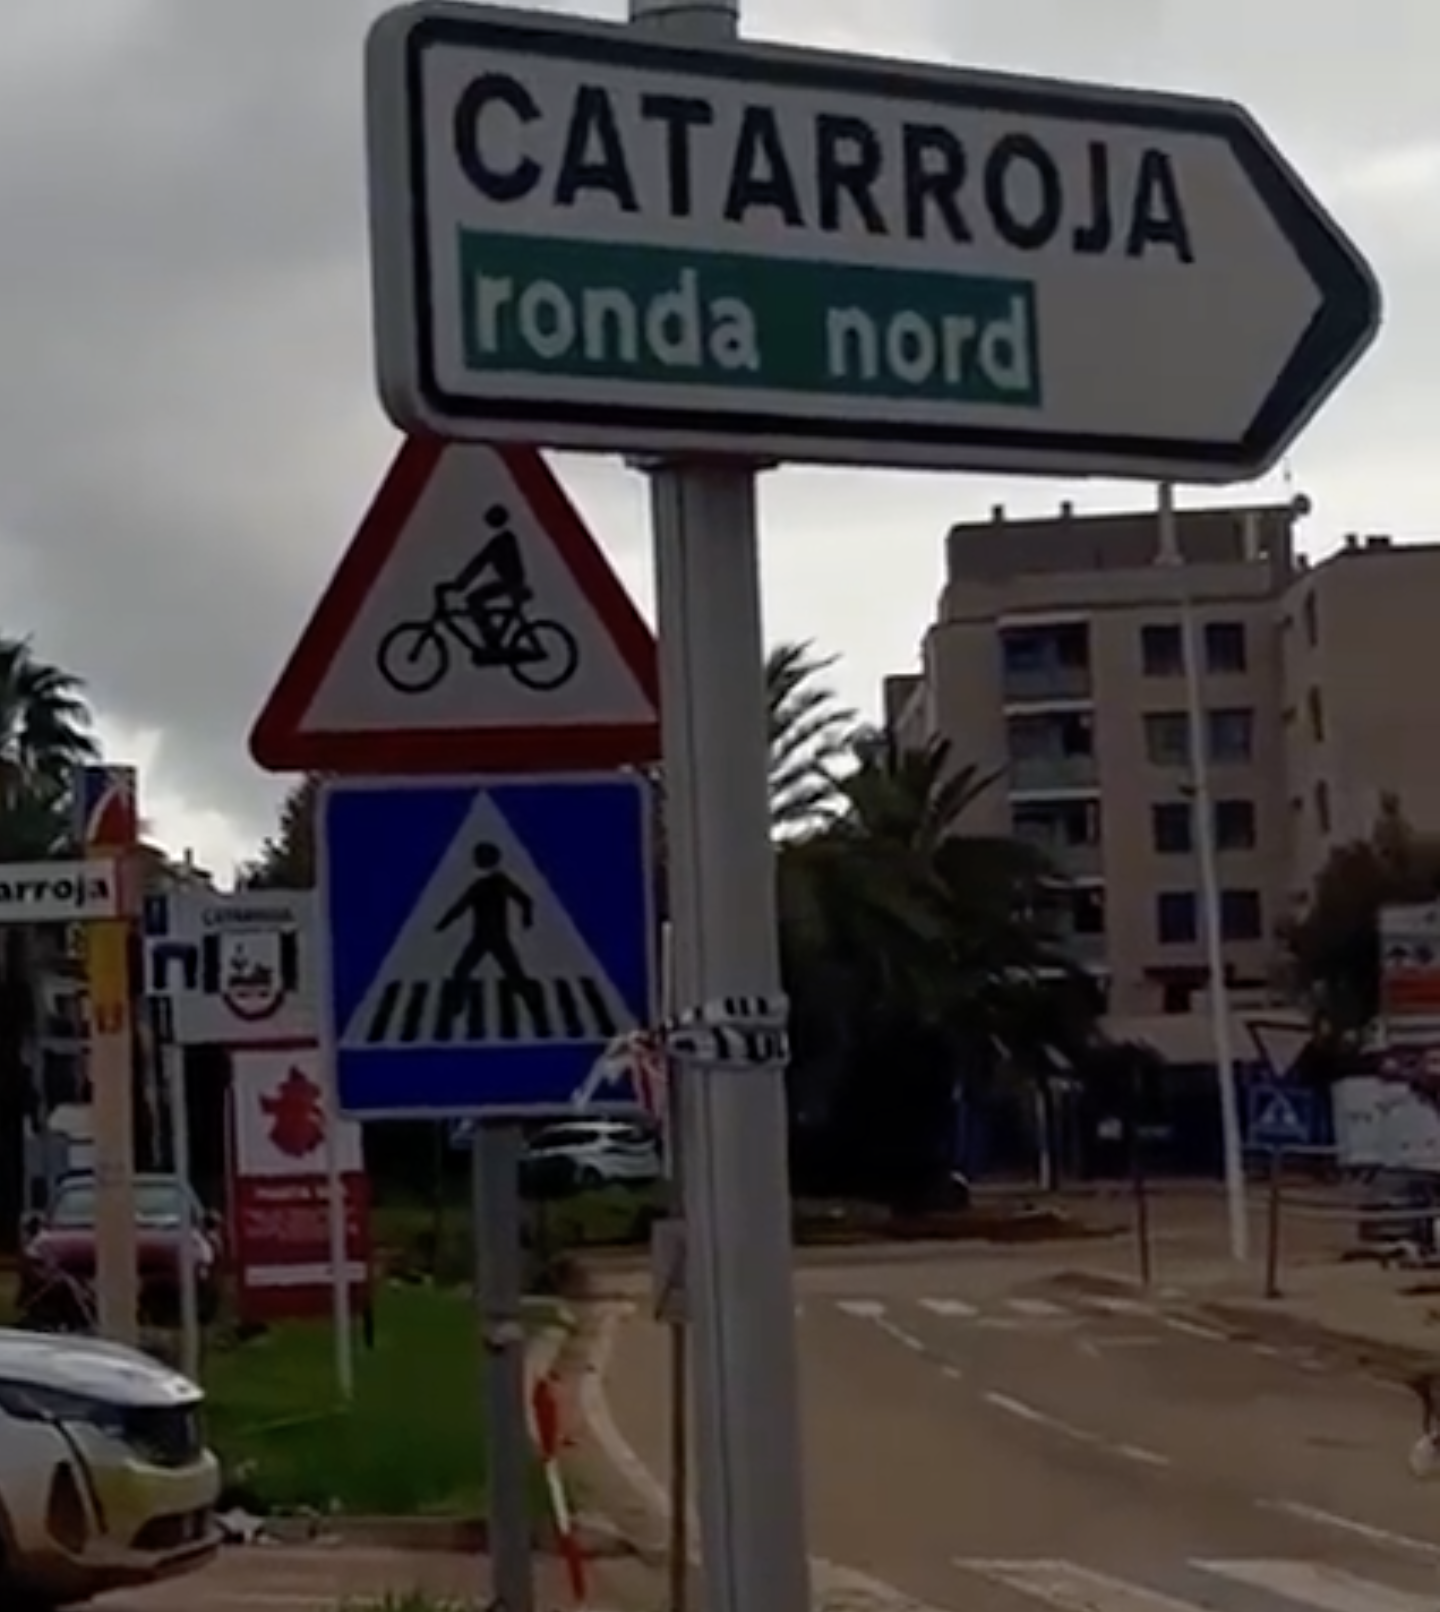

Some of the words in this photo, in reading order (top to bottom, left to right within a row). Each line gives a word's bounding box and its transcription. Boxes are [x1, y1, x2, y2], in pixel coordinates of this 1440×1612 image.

[452, 72, 1194, 265] CATARROJA
[473, 268, 759, 371] ronda
[827, 296, 1031, 392] nord
